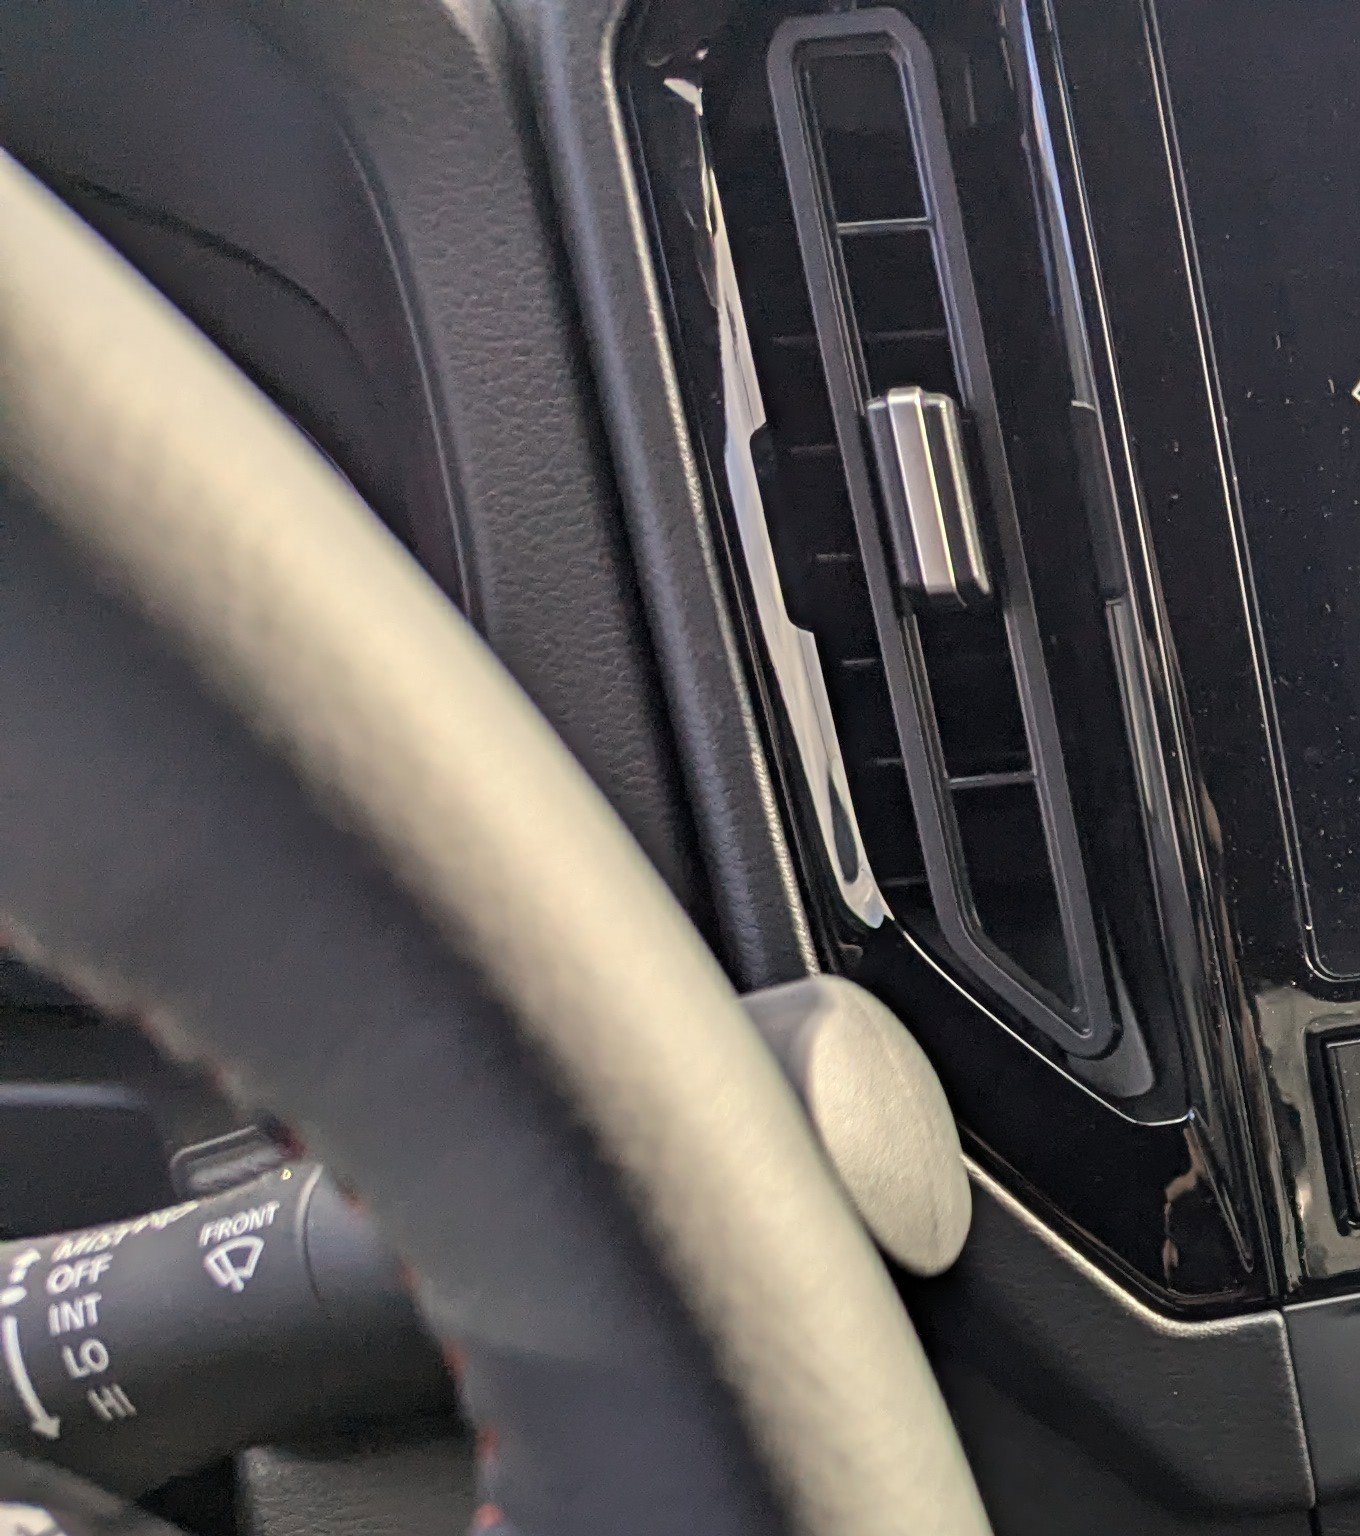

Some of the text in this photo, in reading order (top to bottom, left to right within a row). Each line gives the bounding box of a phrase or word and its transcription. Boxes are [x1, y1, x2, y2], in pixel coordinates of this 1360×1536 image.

[199, 1201, 280, 1246] FRONT
[46, 1252, 113, 1294] OFF
[49, 1292, 101, 1335] INT
[62, 1338, 109, 1378] LO
[88, 1383, 137, 1421] HI
